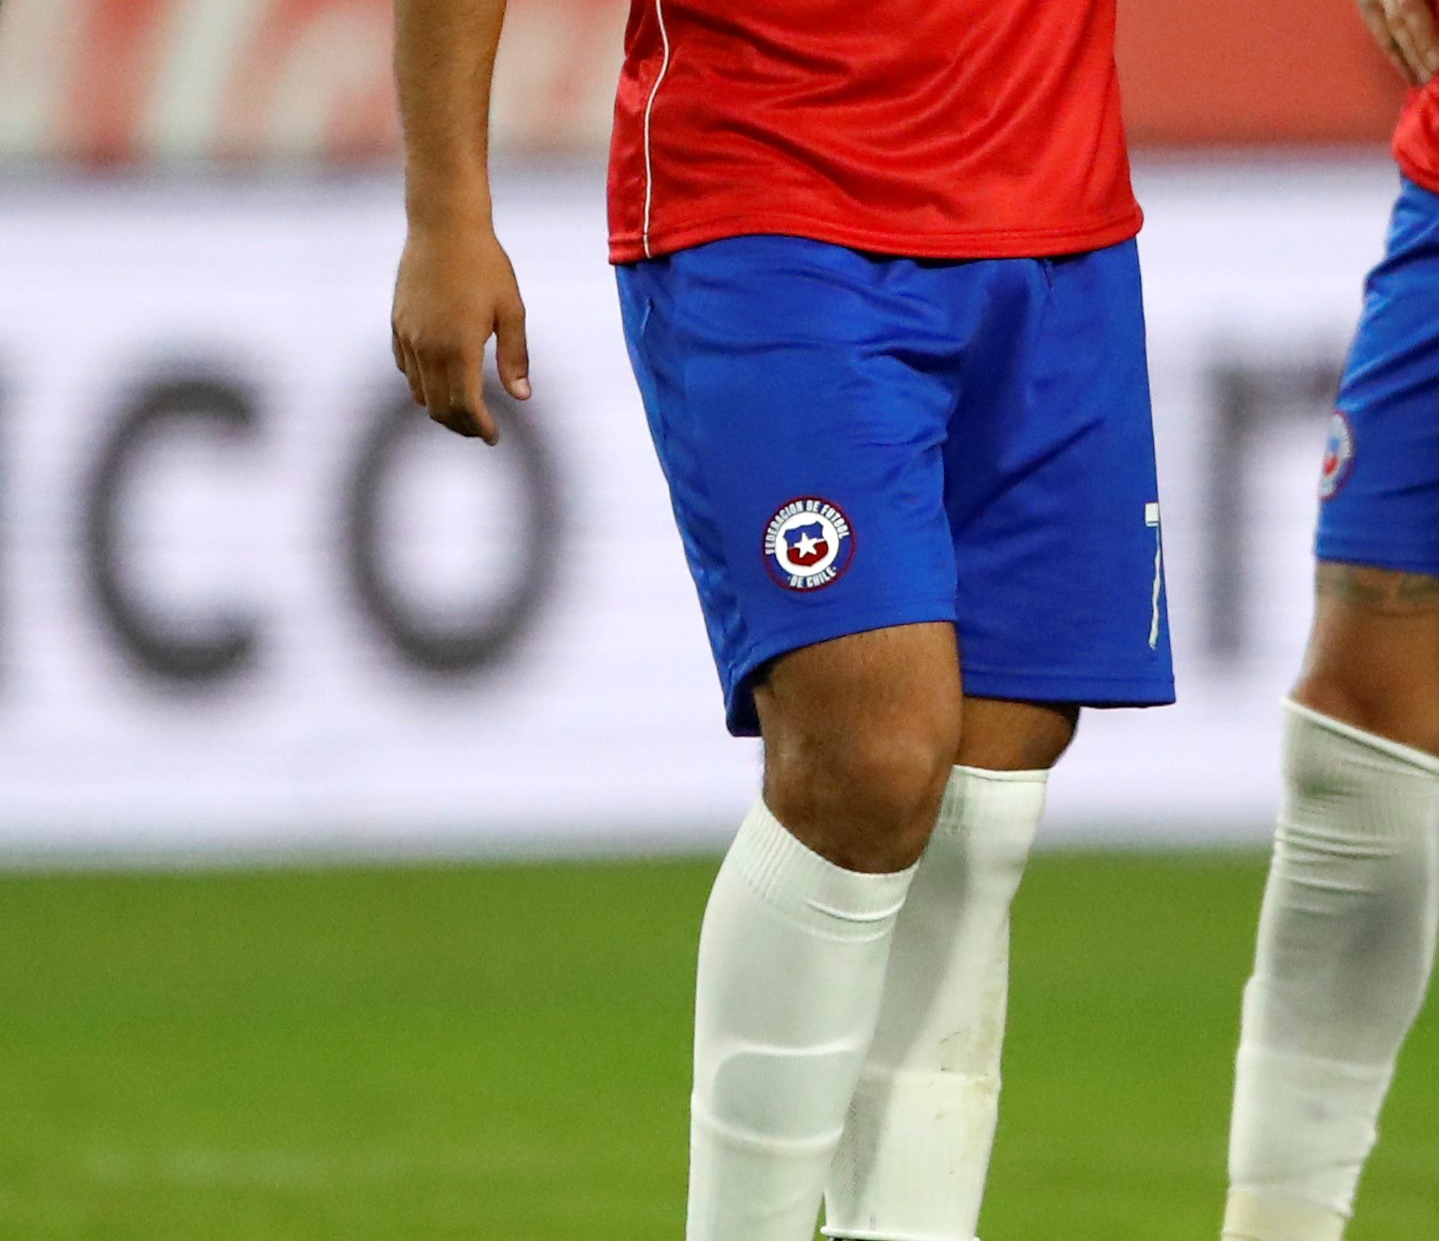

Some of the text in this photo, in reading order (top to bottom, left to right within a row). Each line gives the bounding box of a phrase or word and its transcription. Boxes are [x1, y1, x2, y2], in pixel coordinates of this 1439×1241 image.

[764, 500, 850, 555] FEDERACION DE FUTBOL
[789, 566, 838, 588] DE CHILE
